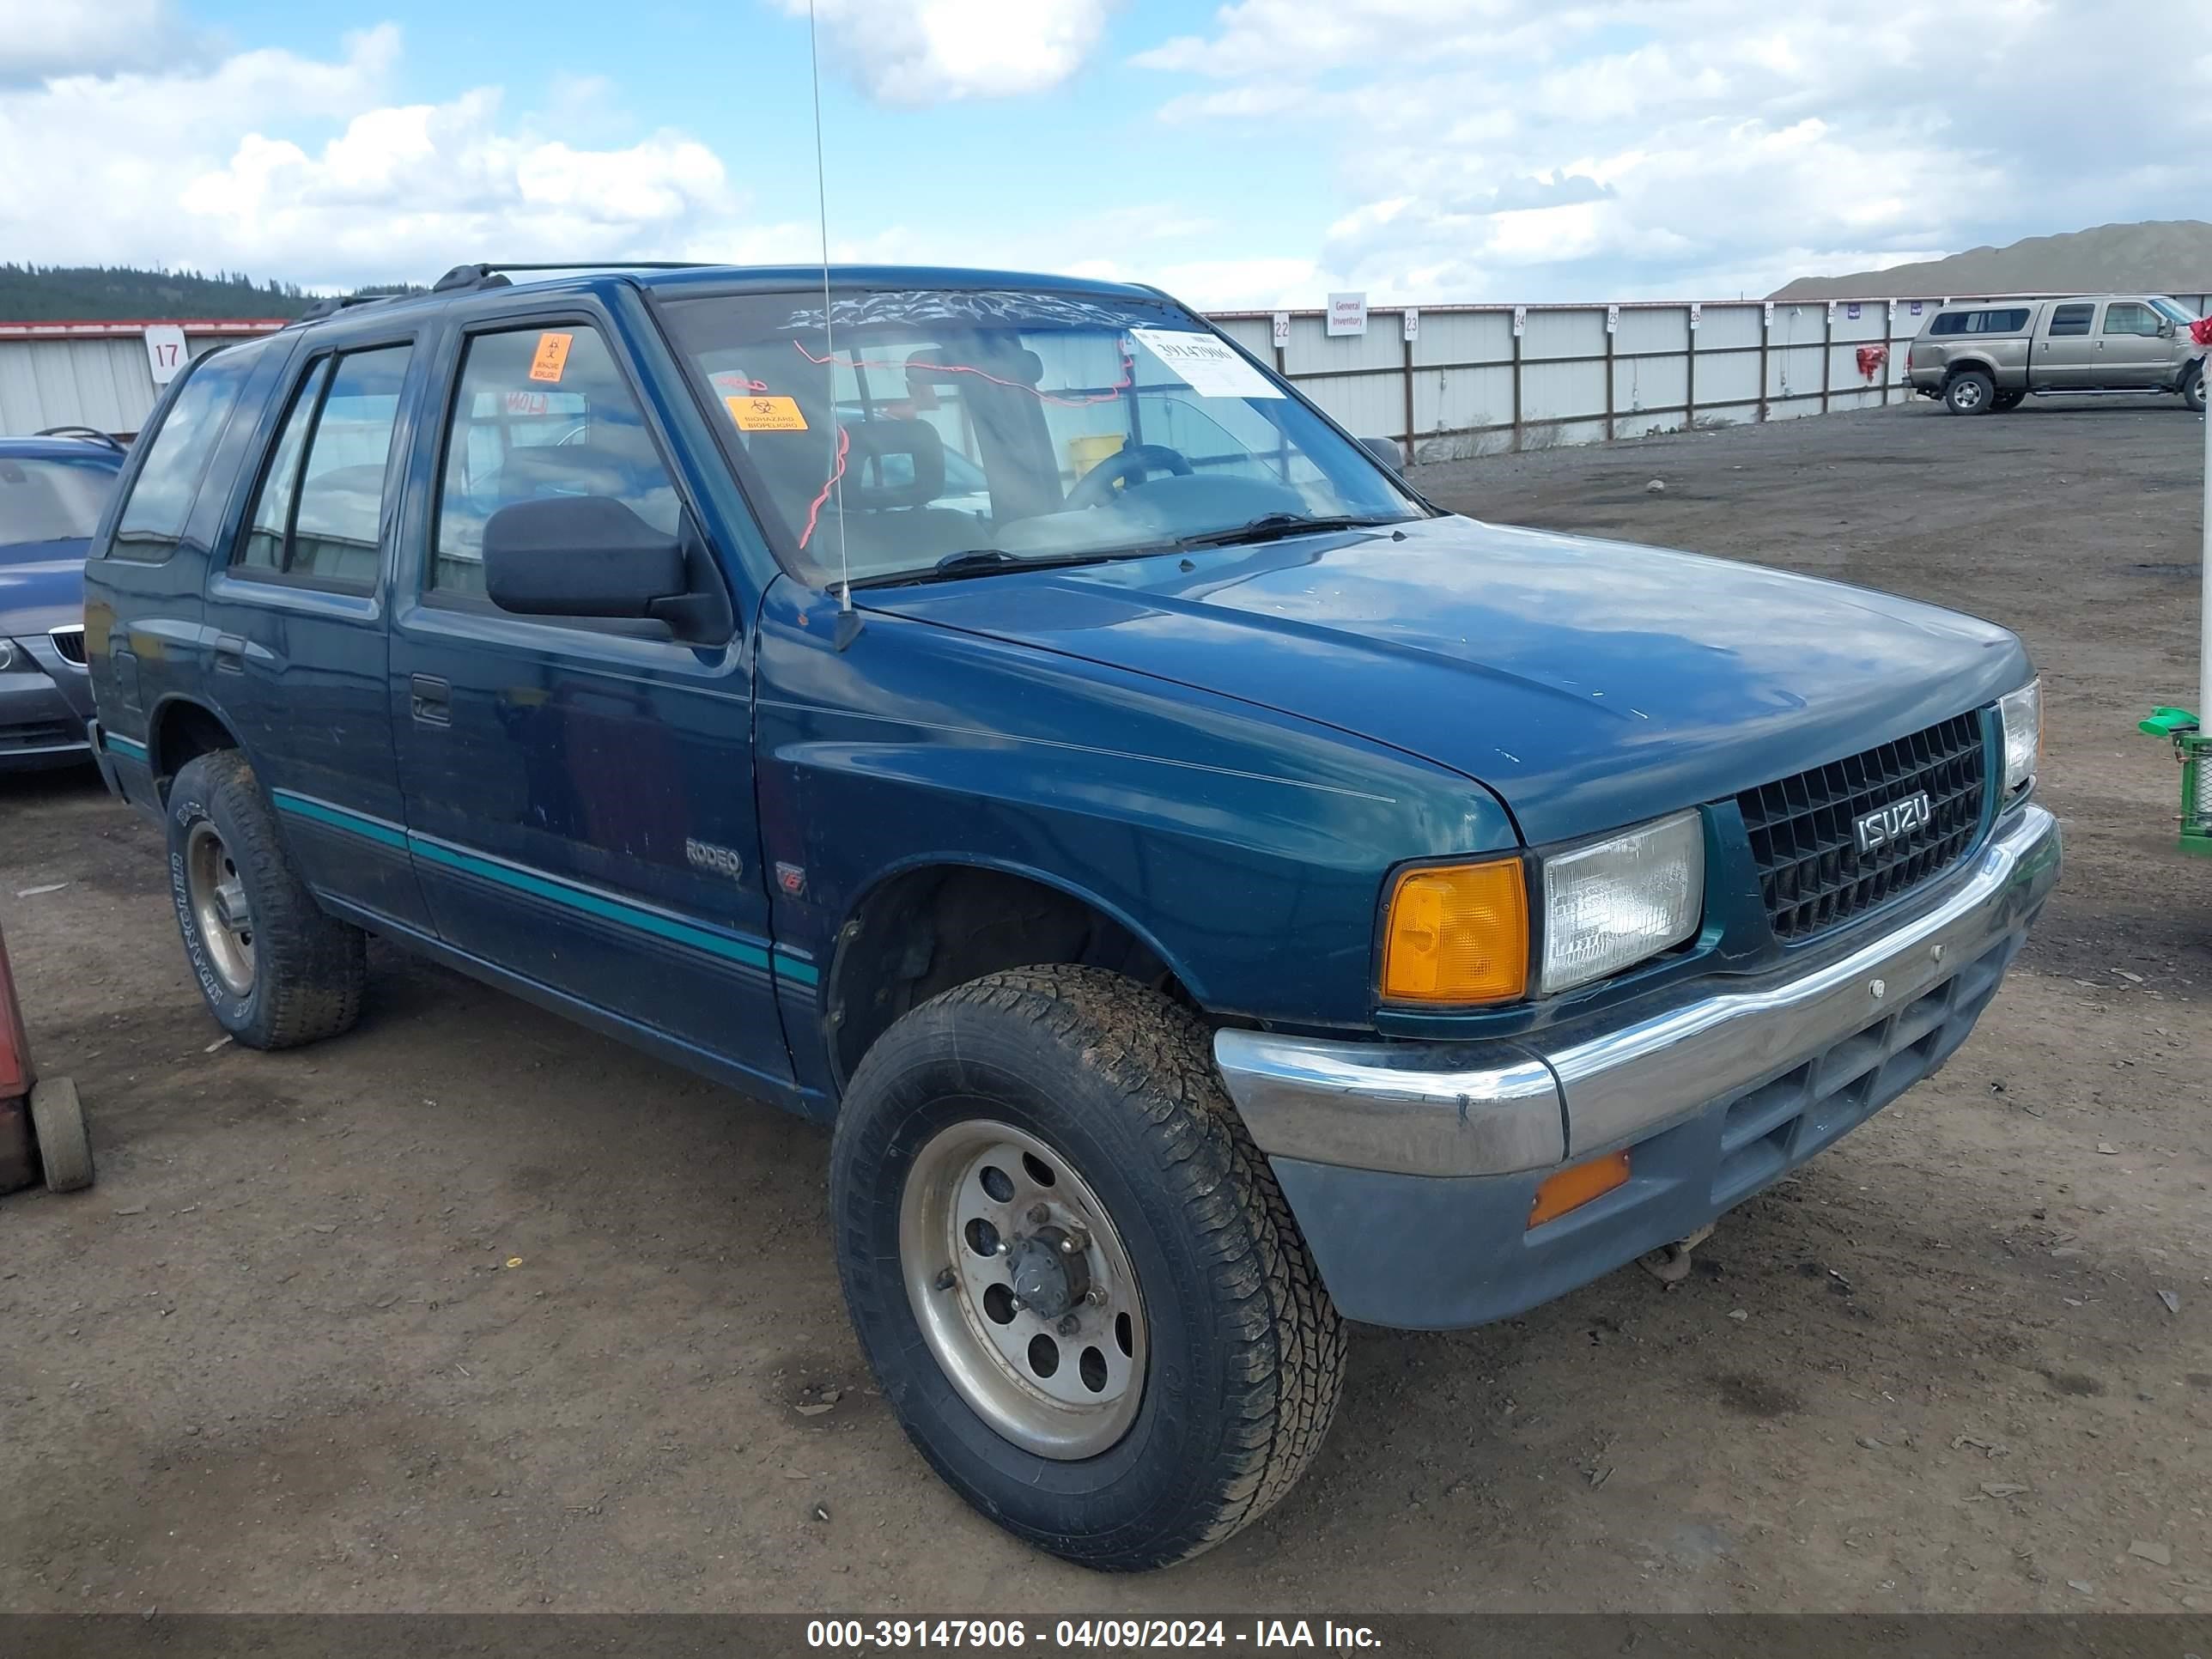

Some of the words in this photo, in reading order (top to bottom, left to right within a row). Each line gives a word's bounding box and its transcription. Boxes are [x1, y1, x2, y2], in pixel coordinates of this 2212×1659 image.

[1336, 301, 1360, 310] General
[1333, 316, 1363, 326] Inventory
[1516, 314, 1524, 327] 24
[1609, 312, 1618, 325] 25
[1692, 310, 1700, 322] 26
[1276, 322, 1289, 337] 22
[1406, 317, 1417, 331] 23
[155, 344, 178, 368] 17
[1157, 343, 1233, 360] 39147906
[1858, 794, 1930, 850] ISUZU
[686, 837, 743, 874] RODEO
[171, 852, 223, 1006] WRANGLER
